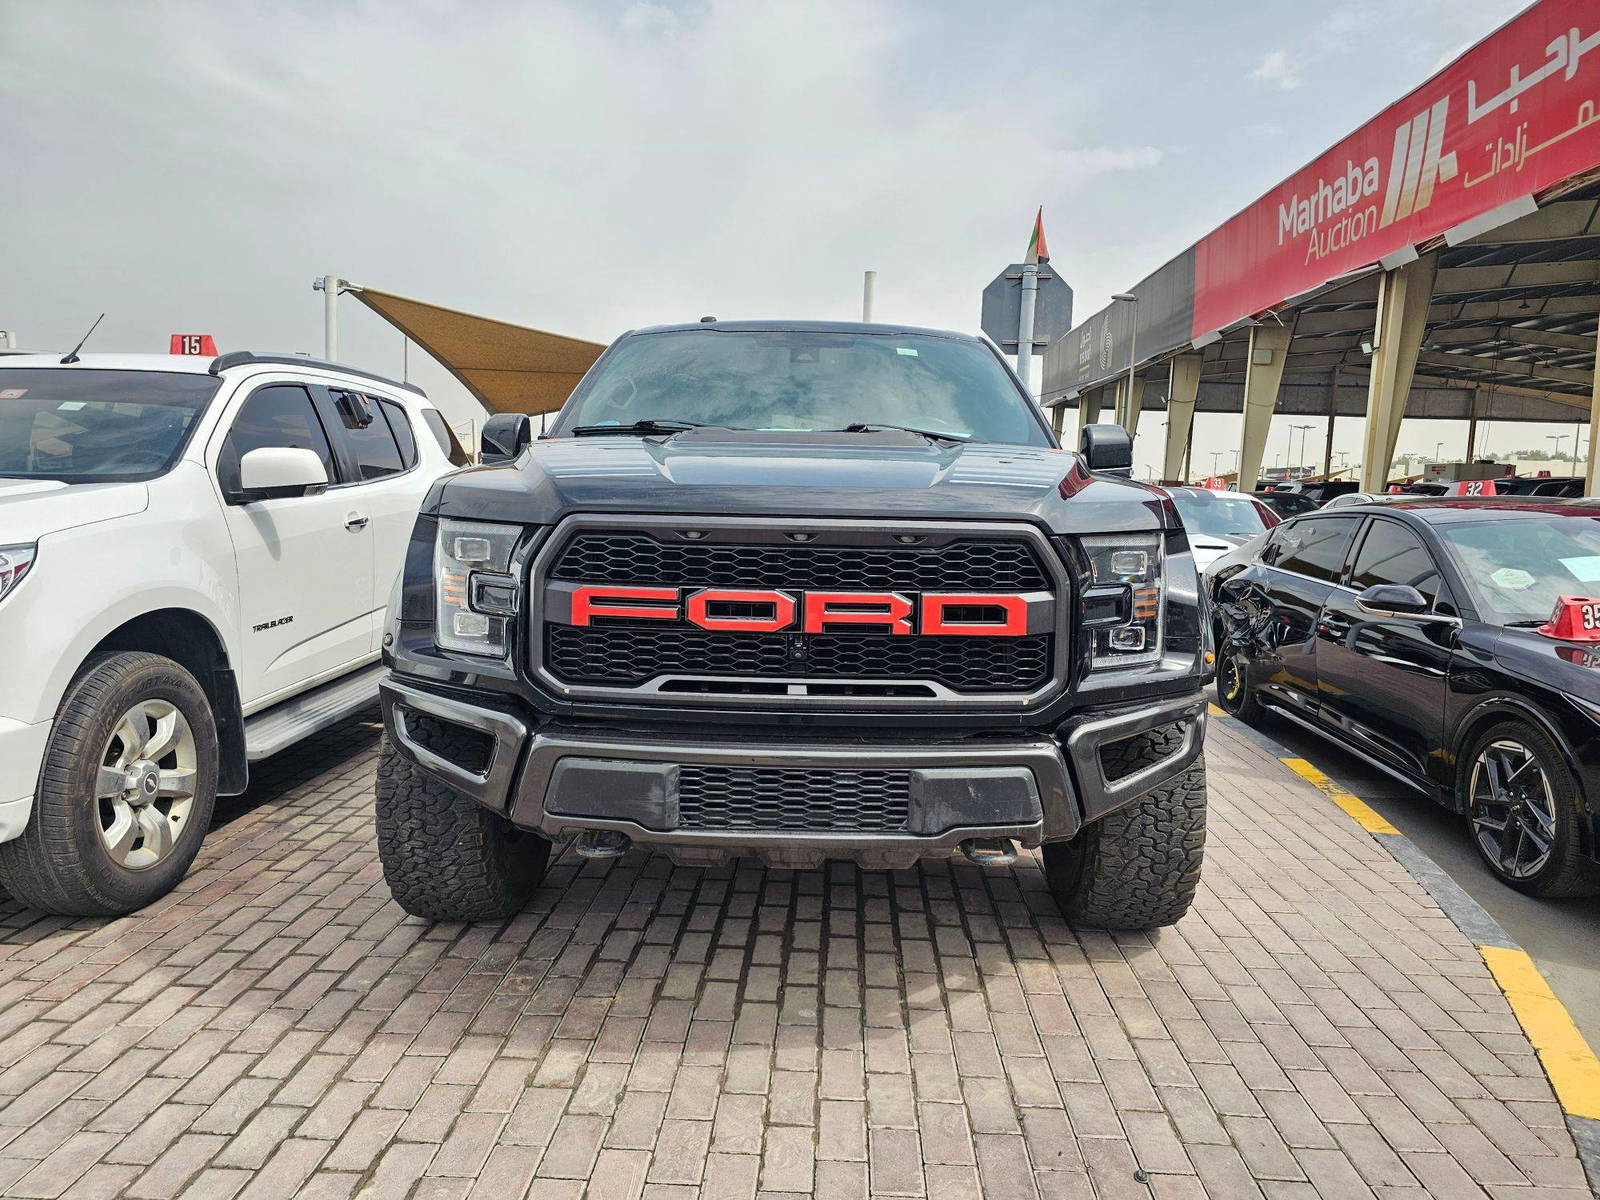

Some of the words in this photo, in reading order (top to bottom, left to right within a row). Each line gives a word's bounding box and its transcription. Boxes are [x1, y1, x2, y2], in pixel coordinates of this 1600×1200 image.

[1467, 27, 1600, 125] رحبا
[1278, 156, 1379, 245] Marhaba
[1304, 205, 1377, 265] Auction
[183, 335, 201, 354] 15
[1466, 482, 1483, 496] 32
[572, 585, 1027, 636] FORD
